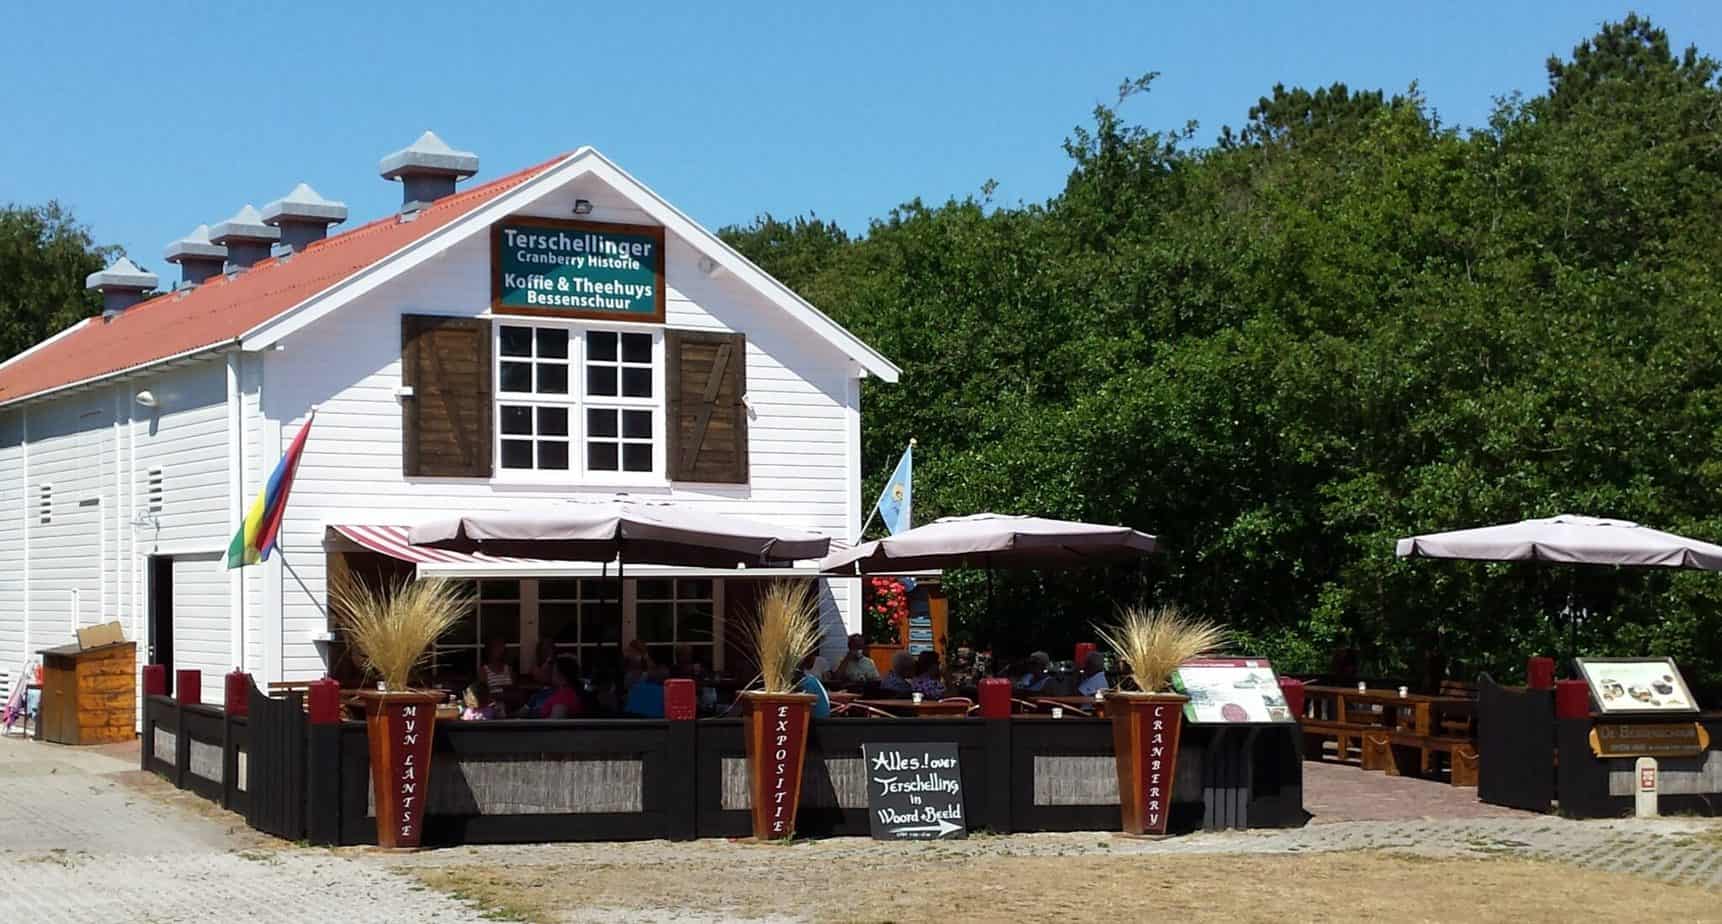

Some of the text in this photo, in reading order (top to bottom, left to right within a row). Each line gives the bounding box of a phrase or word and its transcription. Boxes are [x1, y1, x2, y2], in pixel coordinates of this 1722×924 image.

[504, 229, 652, 258] Terschellinger
[517, 250, 640, 270] Cranberry Historie
[504, 273, 652, 298] Koffie & Theehuys
[527, 290, 631, 309] Bessenschuur
[773, 705, 789, 832] EXPOSITIE
[401, 754, 416, 836] LANTSE
[873, 772, 959, 797] Terschelling
[909, 794, 922, 805] in
[877, 807, 919, 824] Woord
